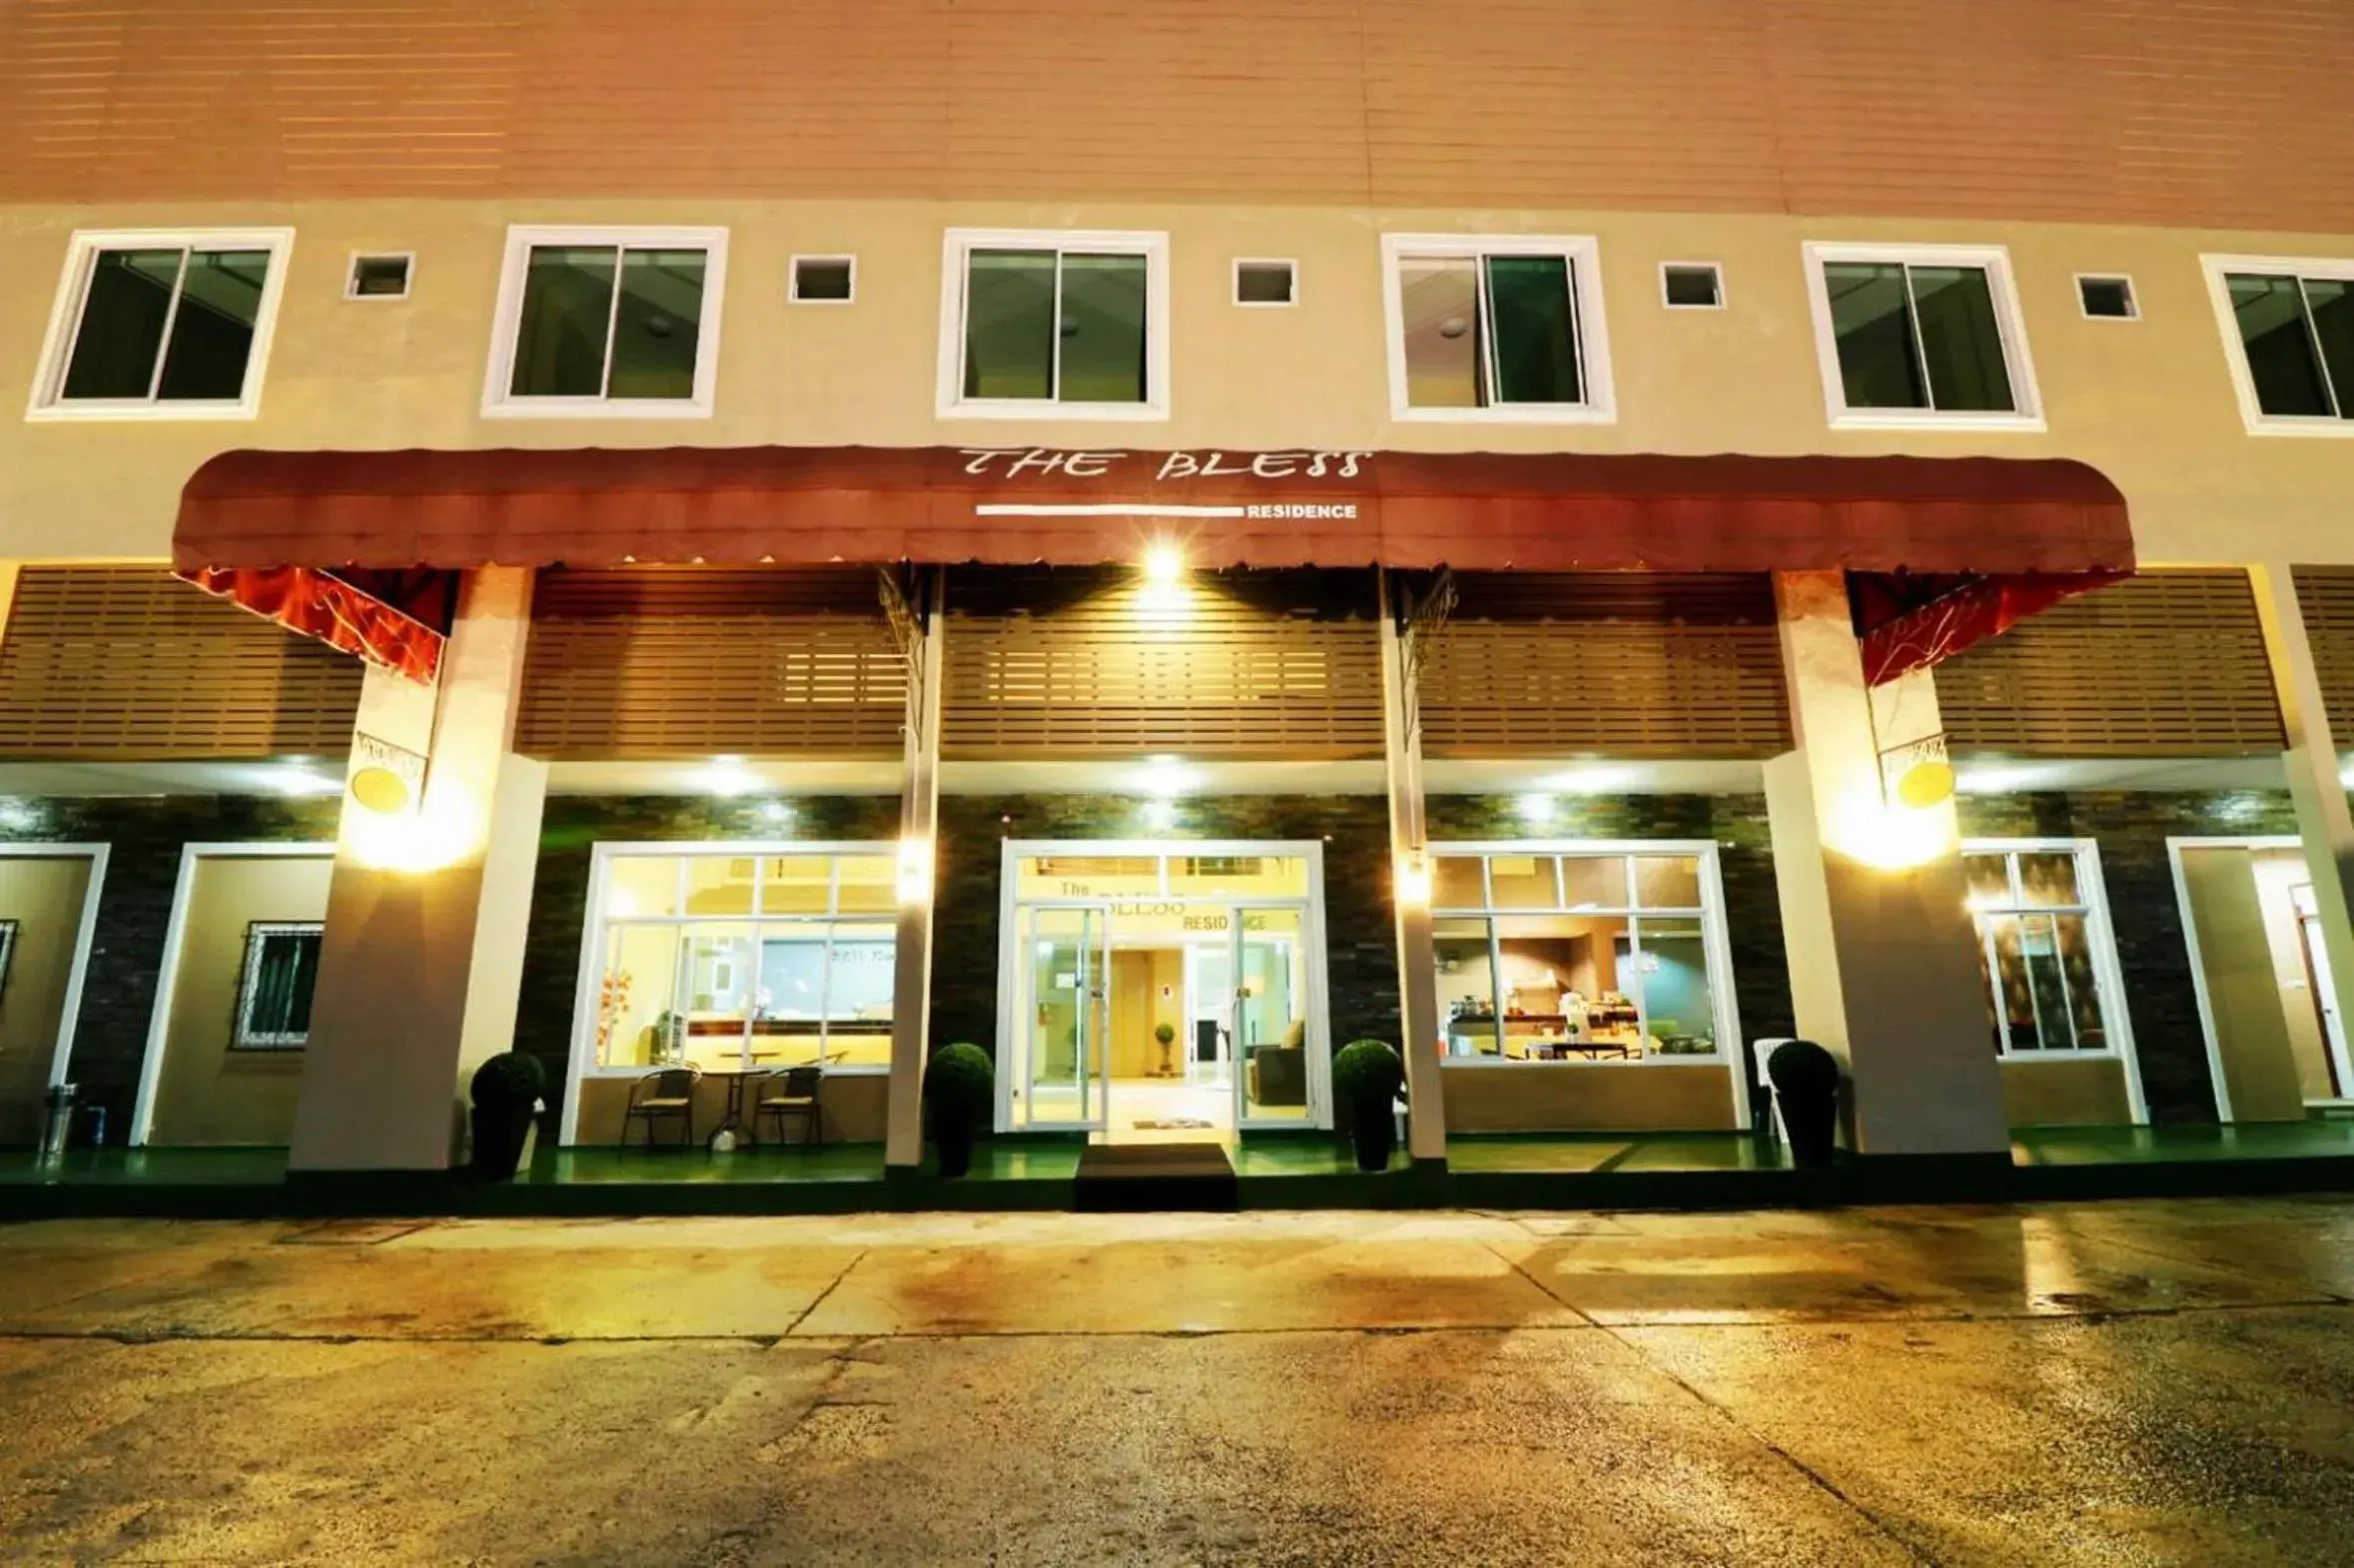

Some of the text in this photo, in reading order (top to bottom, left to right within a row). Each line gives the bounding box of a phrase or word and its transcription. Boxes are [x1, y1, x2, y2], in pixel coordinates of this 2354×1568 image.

[960, 449, 1373, 480] THE BLESS
[1246, 504, 1357, 519] RESIDENCE
[1182, 915, 1266, 930] RESIDCE
